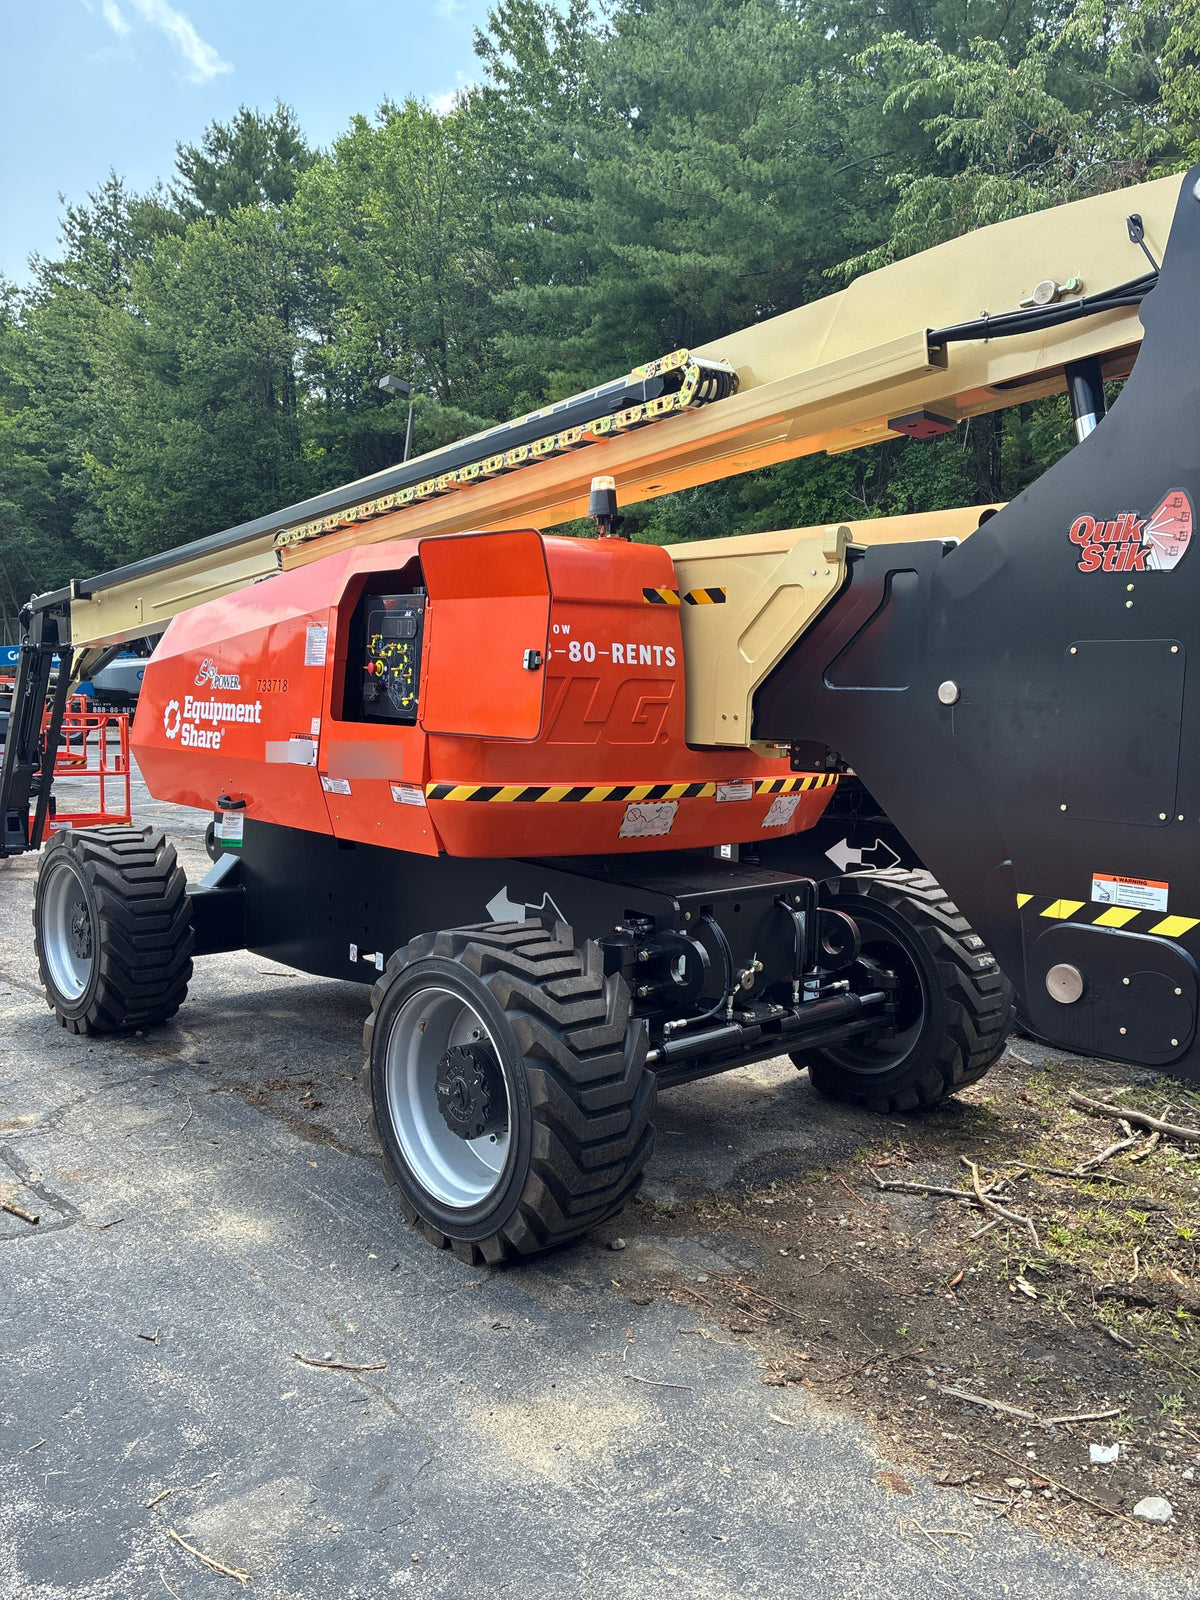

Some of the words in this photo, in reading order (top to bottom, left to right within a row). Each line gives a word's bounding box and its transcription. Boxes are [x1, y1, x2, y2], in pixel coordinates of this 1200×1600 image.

[1069, 513, 1147, 547] Quik
[1078, 543, 1151, 572] Stik
[552, 624, 571, 635] OW
[213, 674, 241, 690] POWER
[257, 679, 288, 692] 733718
[183, 695, 262, 726] Equipment
[1118, 877, 1147, 886] WARNING
